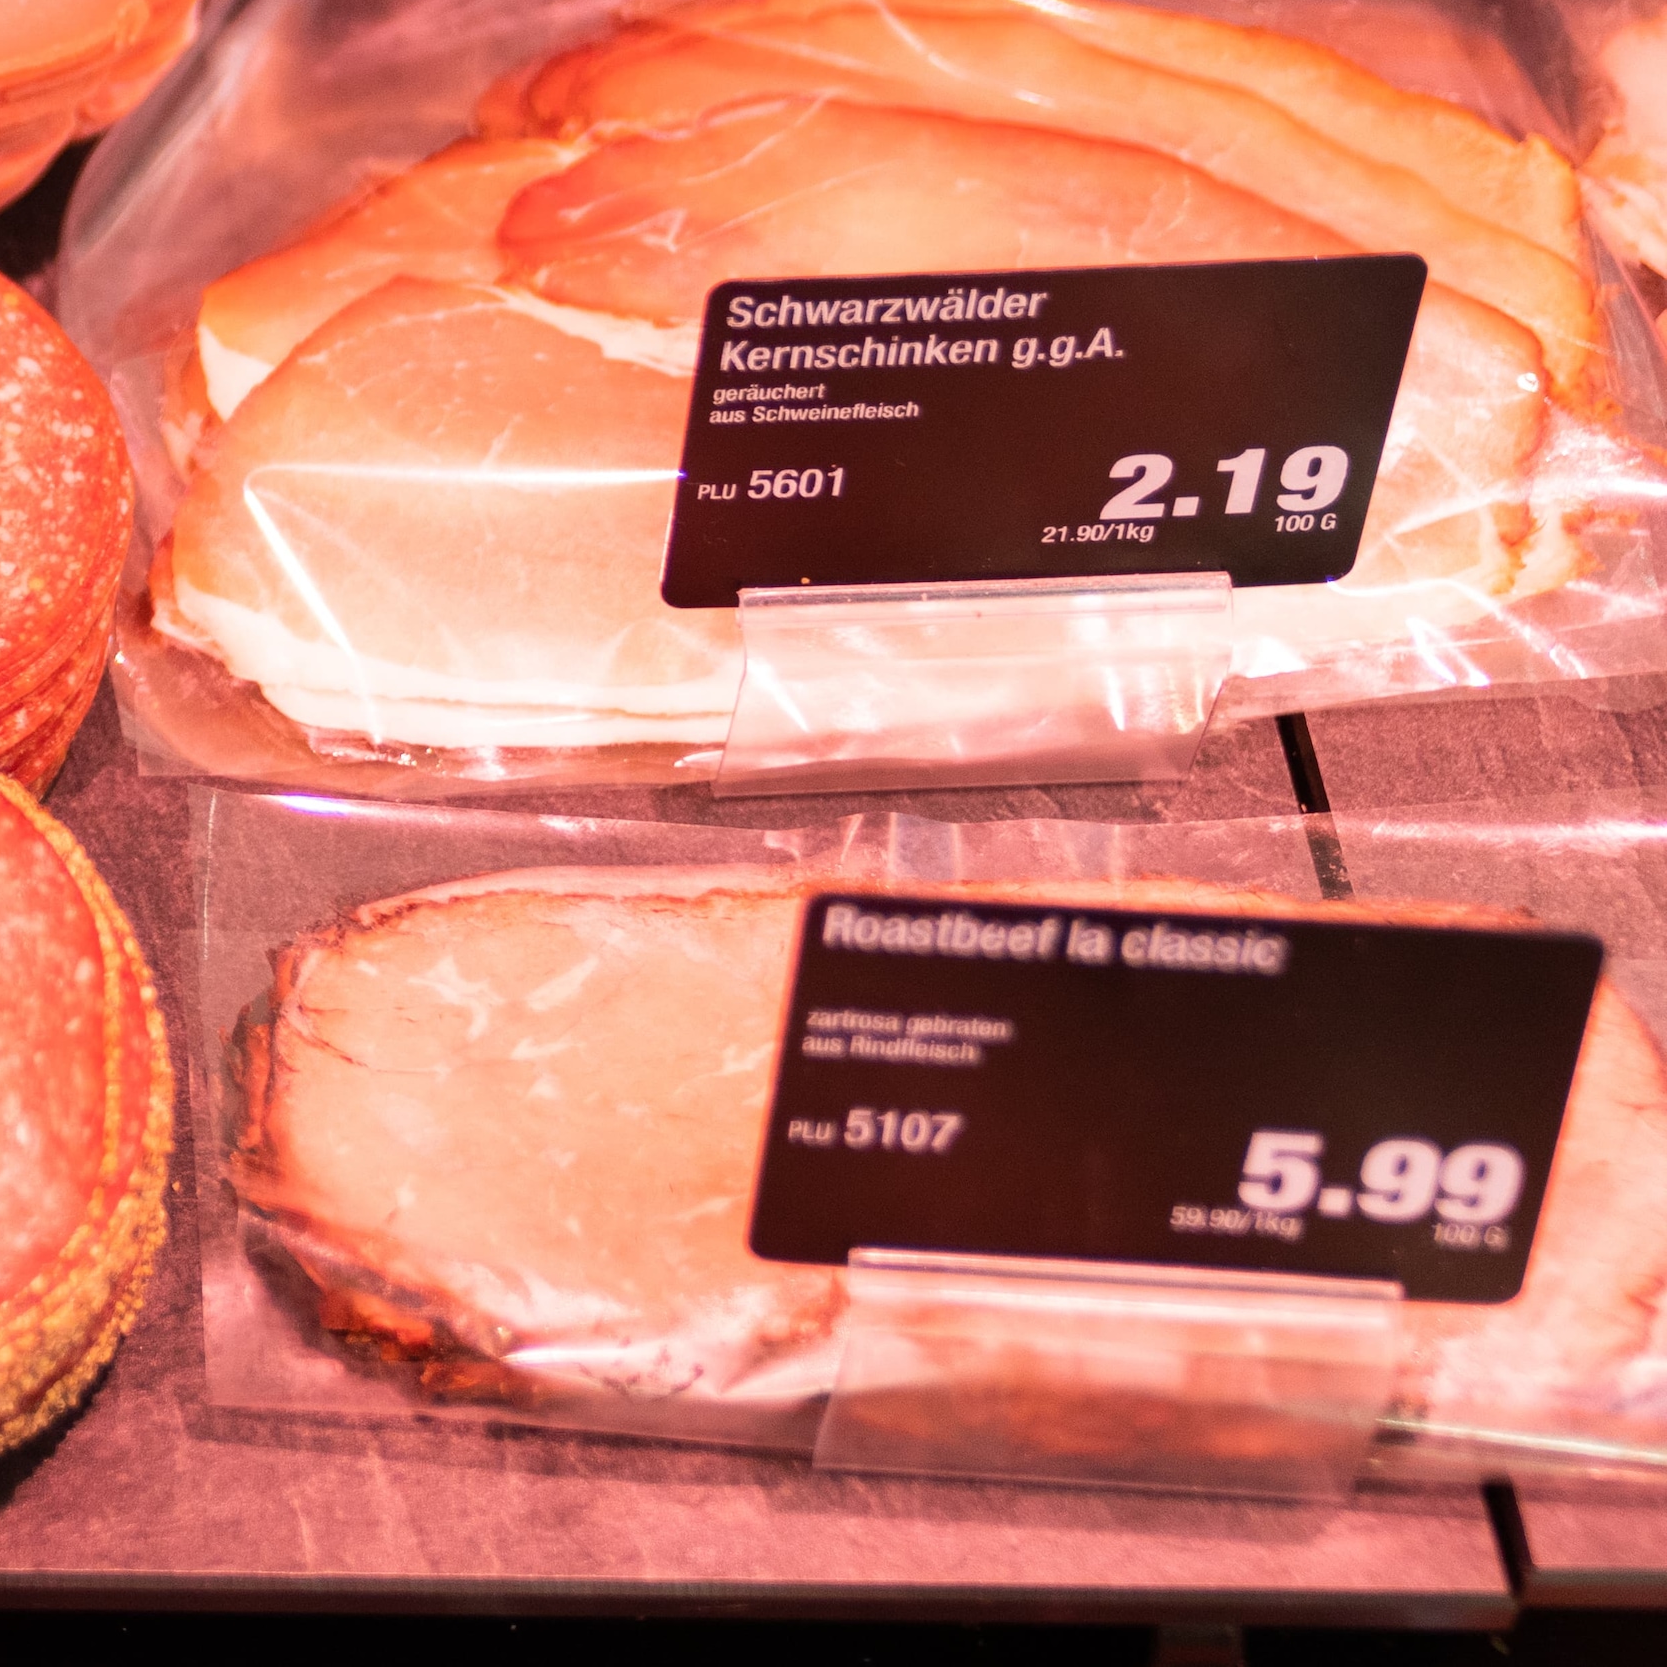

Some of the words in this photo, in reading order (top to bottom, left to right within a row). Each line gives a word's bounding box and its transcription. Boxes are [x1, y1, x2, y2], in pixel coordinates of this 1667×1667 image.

[726, 287, 1048, 330] Schwarzwälder
[720, 334, 998, 373] Kernschinken
[1011, 327, 1124, 370] g.g.A.
[713, 382, 826, 405] geräuchert
[709, 408, 745, 424] aus
[752, 401, 920, 423] Schweinefleisch
[697, 483, 737, 500] PLU
[747, 467, 844, 499] 5601
[1099, 445, 1349, 520] 2.19
[1041, 522, 1155, 544] 21.90/1kg
[1274, 515, 1314, 532] 100
[1319, 513, 1338, 530] G
[823, 903, 1062, 962] Roastbeef
[1067, 918, 1112, 965] la
[1121, 920, 1291, 976] classic
[806, 1009, 902, 1033] zartrosa
[905, 1014, 1014, 1042] gebraten
[802, 1035, 845, 1058] aus
[849, 1034, 982, 1066] Rindfleisch
[788, 1119, 836, 1146] PLU
[844, 1107, 963, 1153] 5107
[1238, 1131, 1524, 1223] 5.99
[1169, 1205, 1303, 1243] 59.90/1kg
[1433, 1223, 1480, 1249] 100
[1483, 1225, 1510, 1251] G
